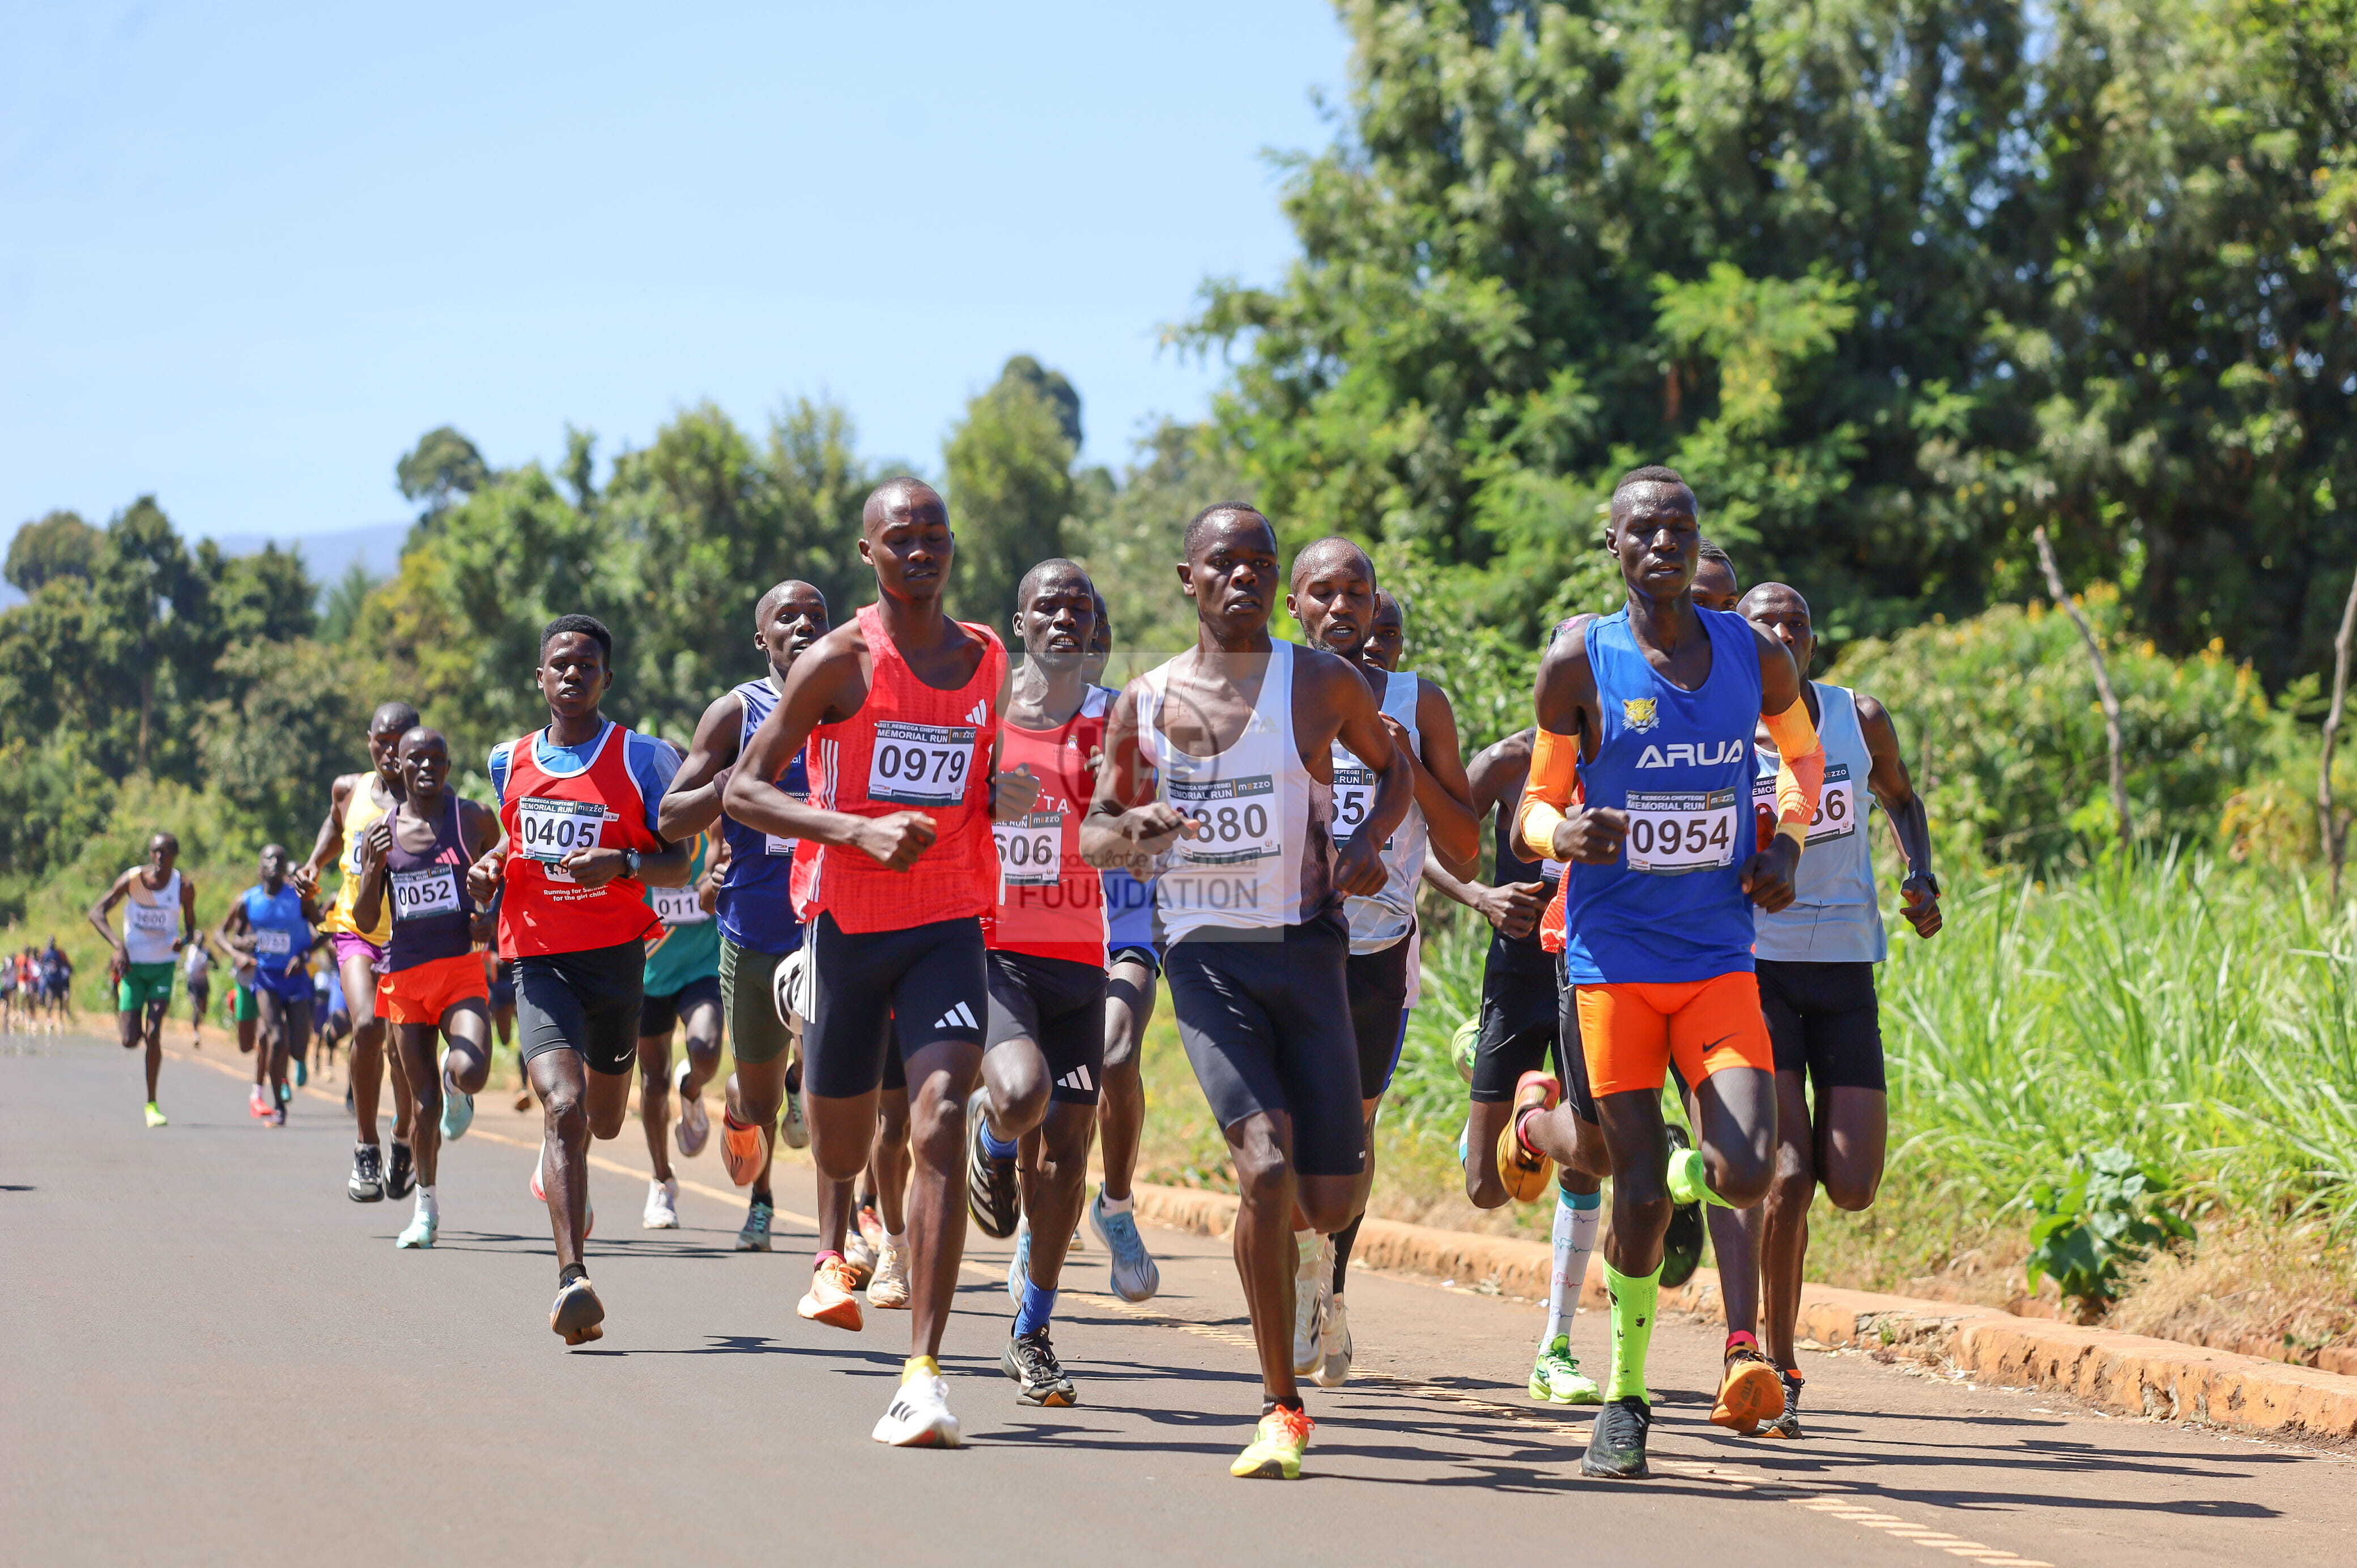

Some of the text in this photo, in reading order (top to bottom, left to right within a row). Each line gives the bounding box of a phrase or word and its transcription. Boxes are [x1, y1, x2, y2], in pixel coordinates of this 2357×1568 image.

[878, 729, 948, 743] MEMORIAL RUN
[1635, 739, 1743, 769] ARUA
[879, 745, 965, 783] 0979
[1169, 788, 1232, 799] MEMORIAL RUN
[521, 802, 556, 812] MEMORIAL
[1627, 801, 1705, 810] MEMORIAL RUN
[1009, 820, 1027, 828] RUN
[525, 817, 596, 848] 0405
[1632, 816, 1729, 855] 0954
[398, 880, 452, 905] 0052
[589, 889, 607, 898] child.
[659, 897, 694, 914] 011
